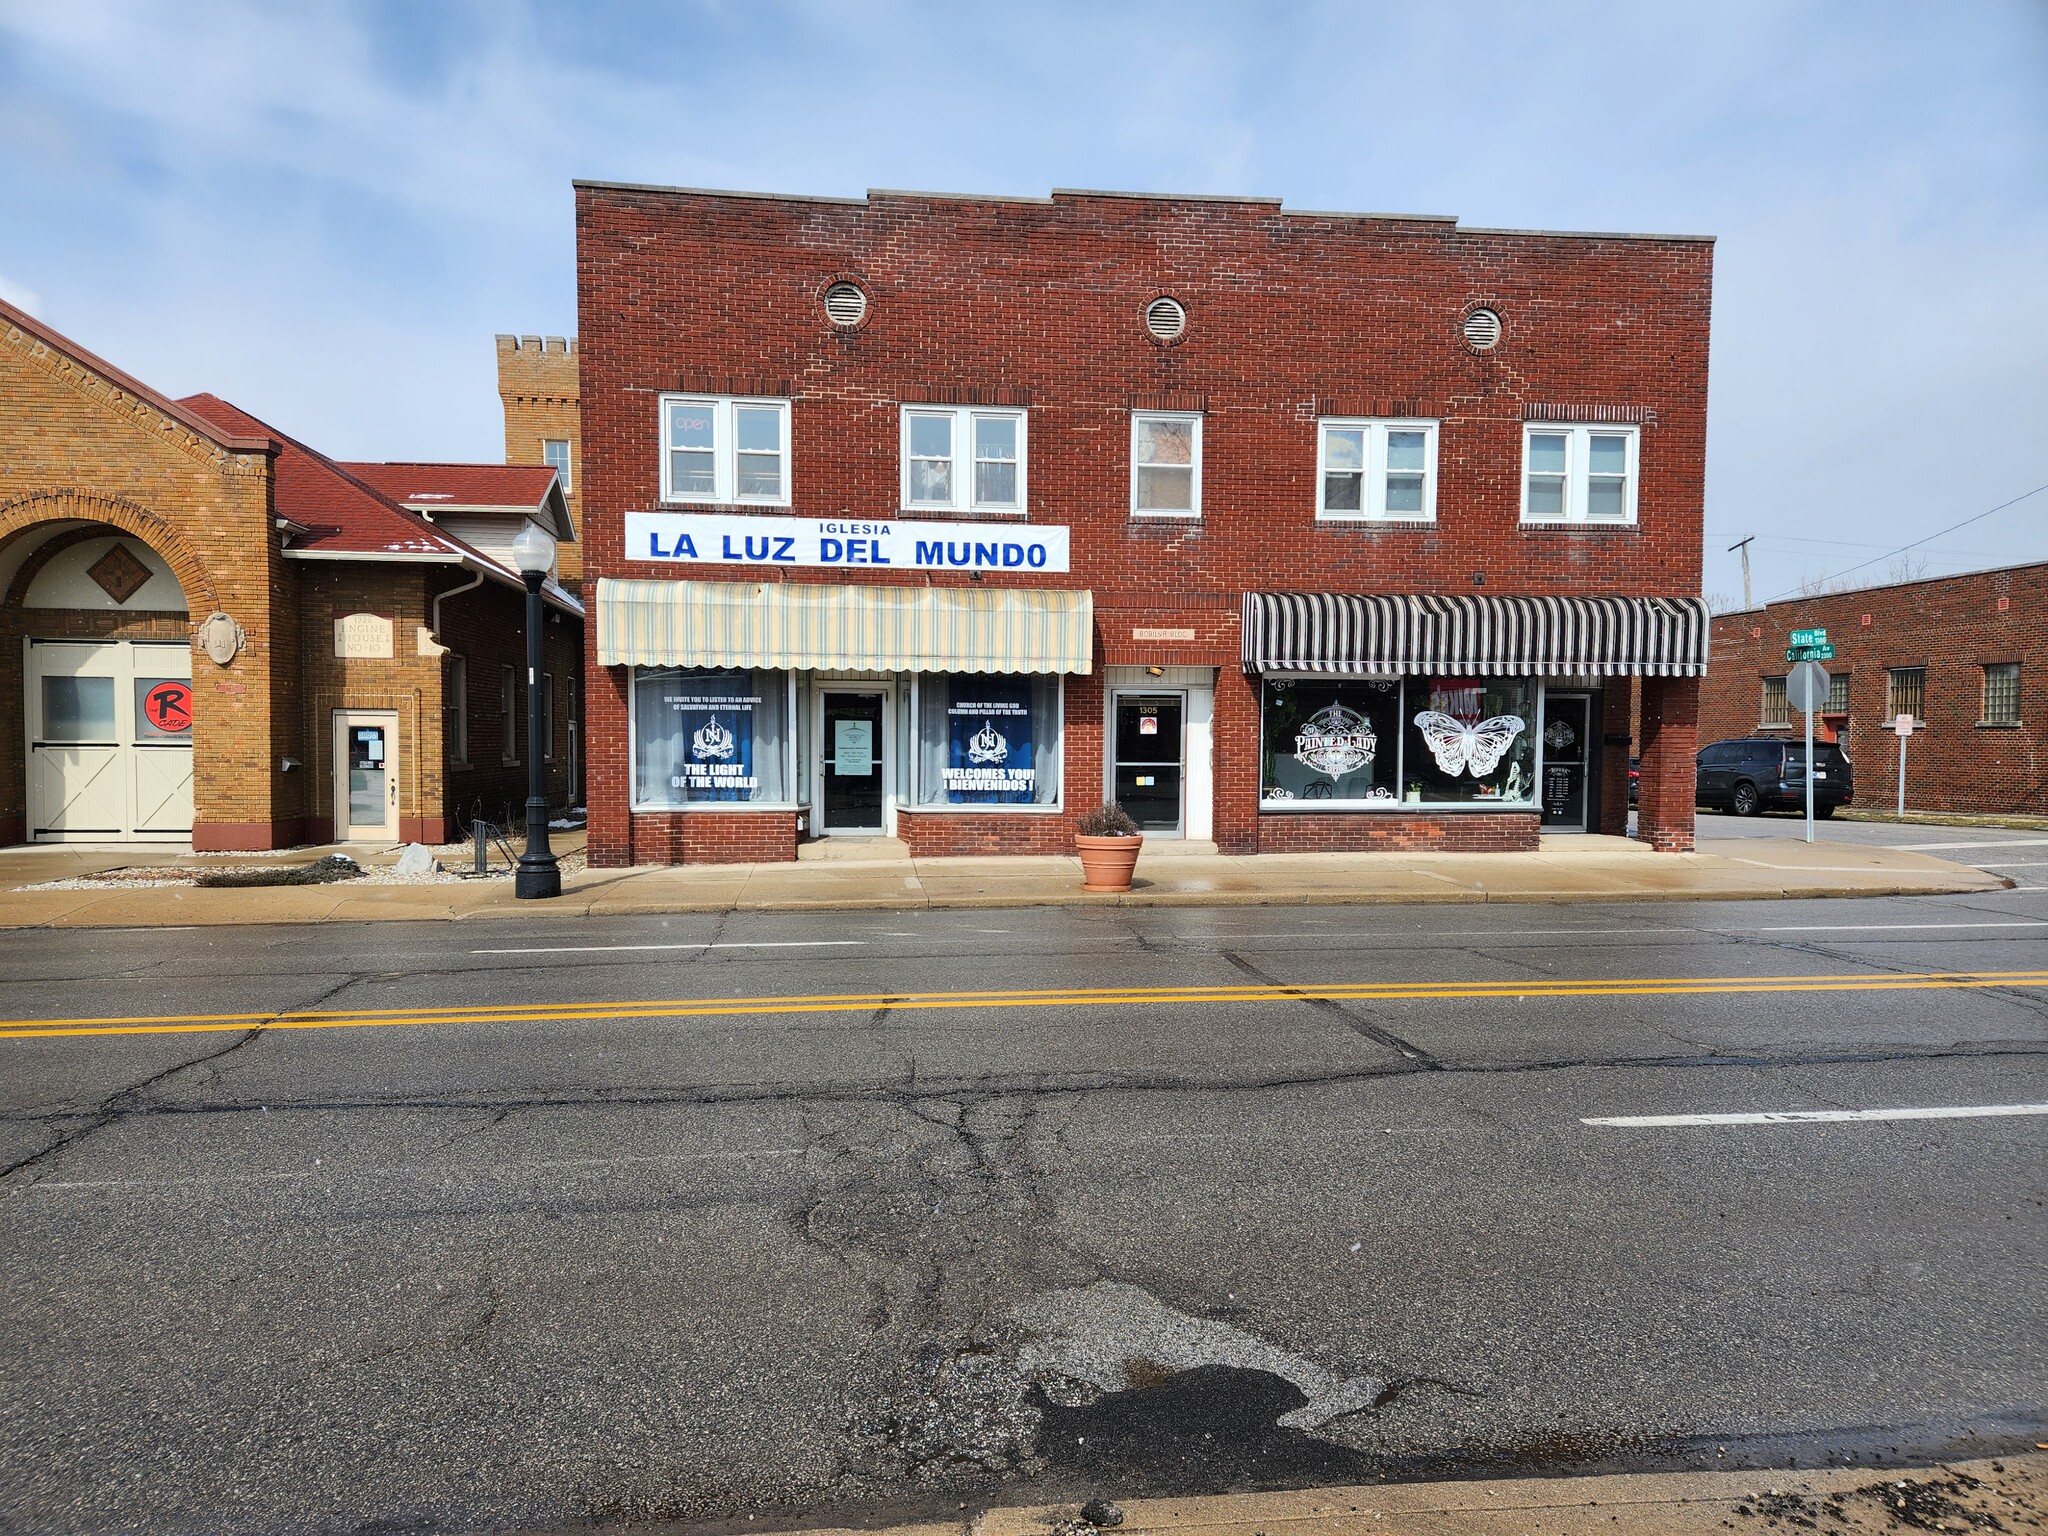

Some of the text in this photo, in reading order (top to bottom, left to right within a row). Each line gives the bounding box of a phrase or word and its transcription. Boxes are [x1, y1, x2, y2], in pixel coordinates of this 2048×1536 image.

[676, 418, 710, 432] open
[820, 523, 890, 535] IGLESIA
[650, 532, 1046, 568] LA LUZ DEL MUNDO
[342, 624, 386, 633] ENGINE
[344, 634, 382, 642] HOUSE
[1792, 632, 1813, 644] State
[1786, 648, 1820, 661] California
[153, 690, 190, 719] R
[1294, 734, 1377, 756] PAINTED LADY
[684, 764, 744, 776] THE LIGHT
[942, 768, 1035, 780] WELCOMES YOU!
[672, 776, 758, 788] OF THE WORLD
